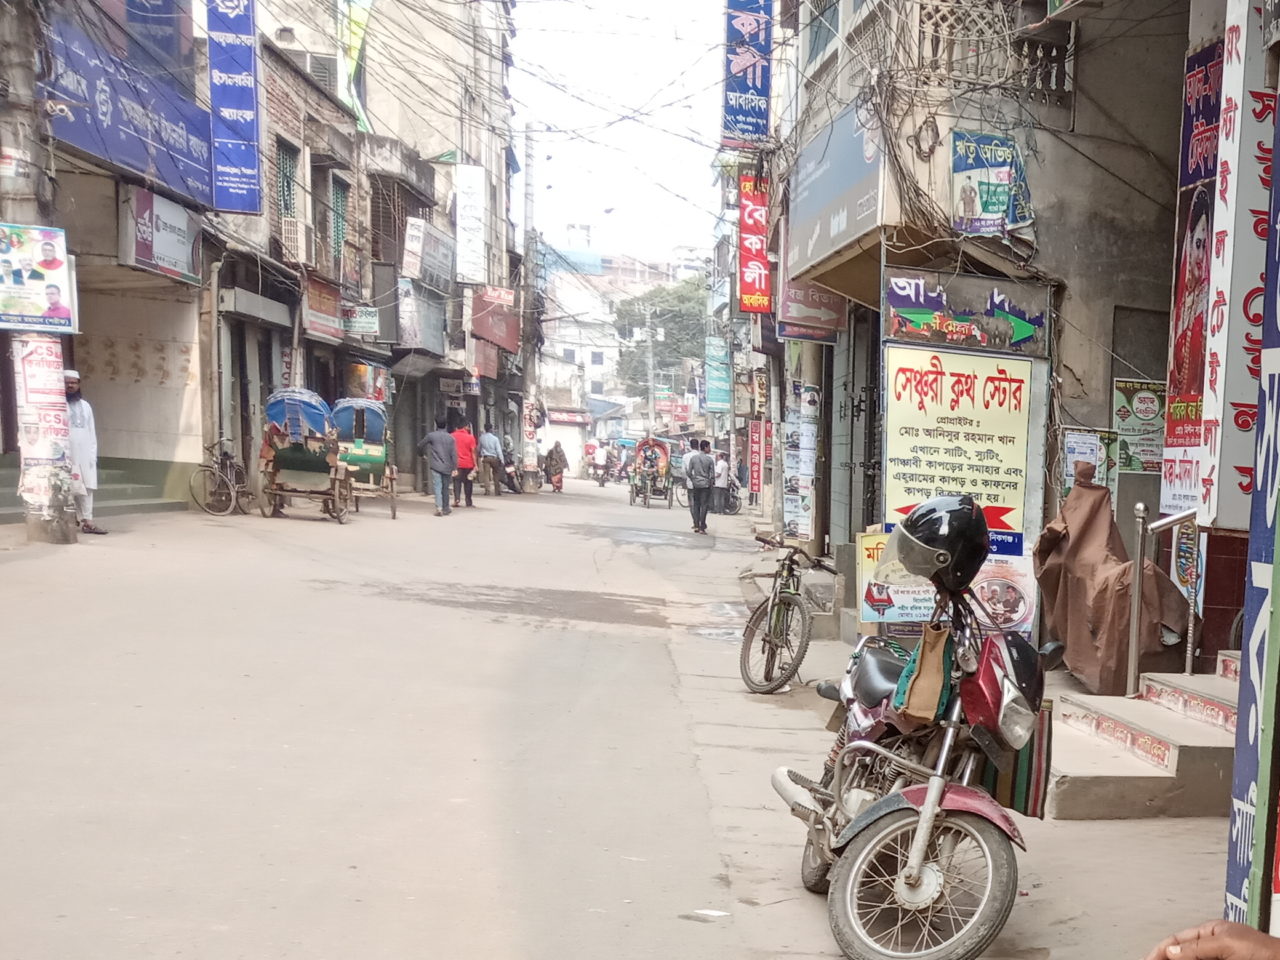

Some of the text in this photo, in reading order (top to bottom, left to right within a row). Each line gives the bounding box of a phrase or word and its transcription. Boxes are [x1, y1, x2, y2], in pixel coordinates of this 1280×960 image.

[950, 370, 978, 411] ক্লথ
[983, 364, 1025, 413] স্টোর
[899, 426, 1016, 446] মোঃ আনিসুর রহমান খান
[910, 445, 941, 456] এখানে
[925, 460, 964, 474] কাপড়ের
[966, 464, 1001, 475] সমাহার
[1004, 468, 1024, 478] এবং
[938, 475, 967, 488] কাপড়
[970, 479, 978, 487] ও
[904, 486, 933, 499] কাপড়
